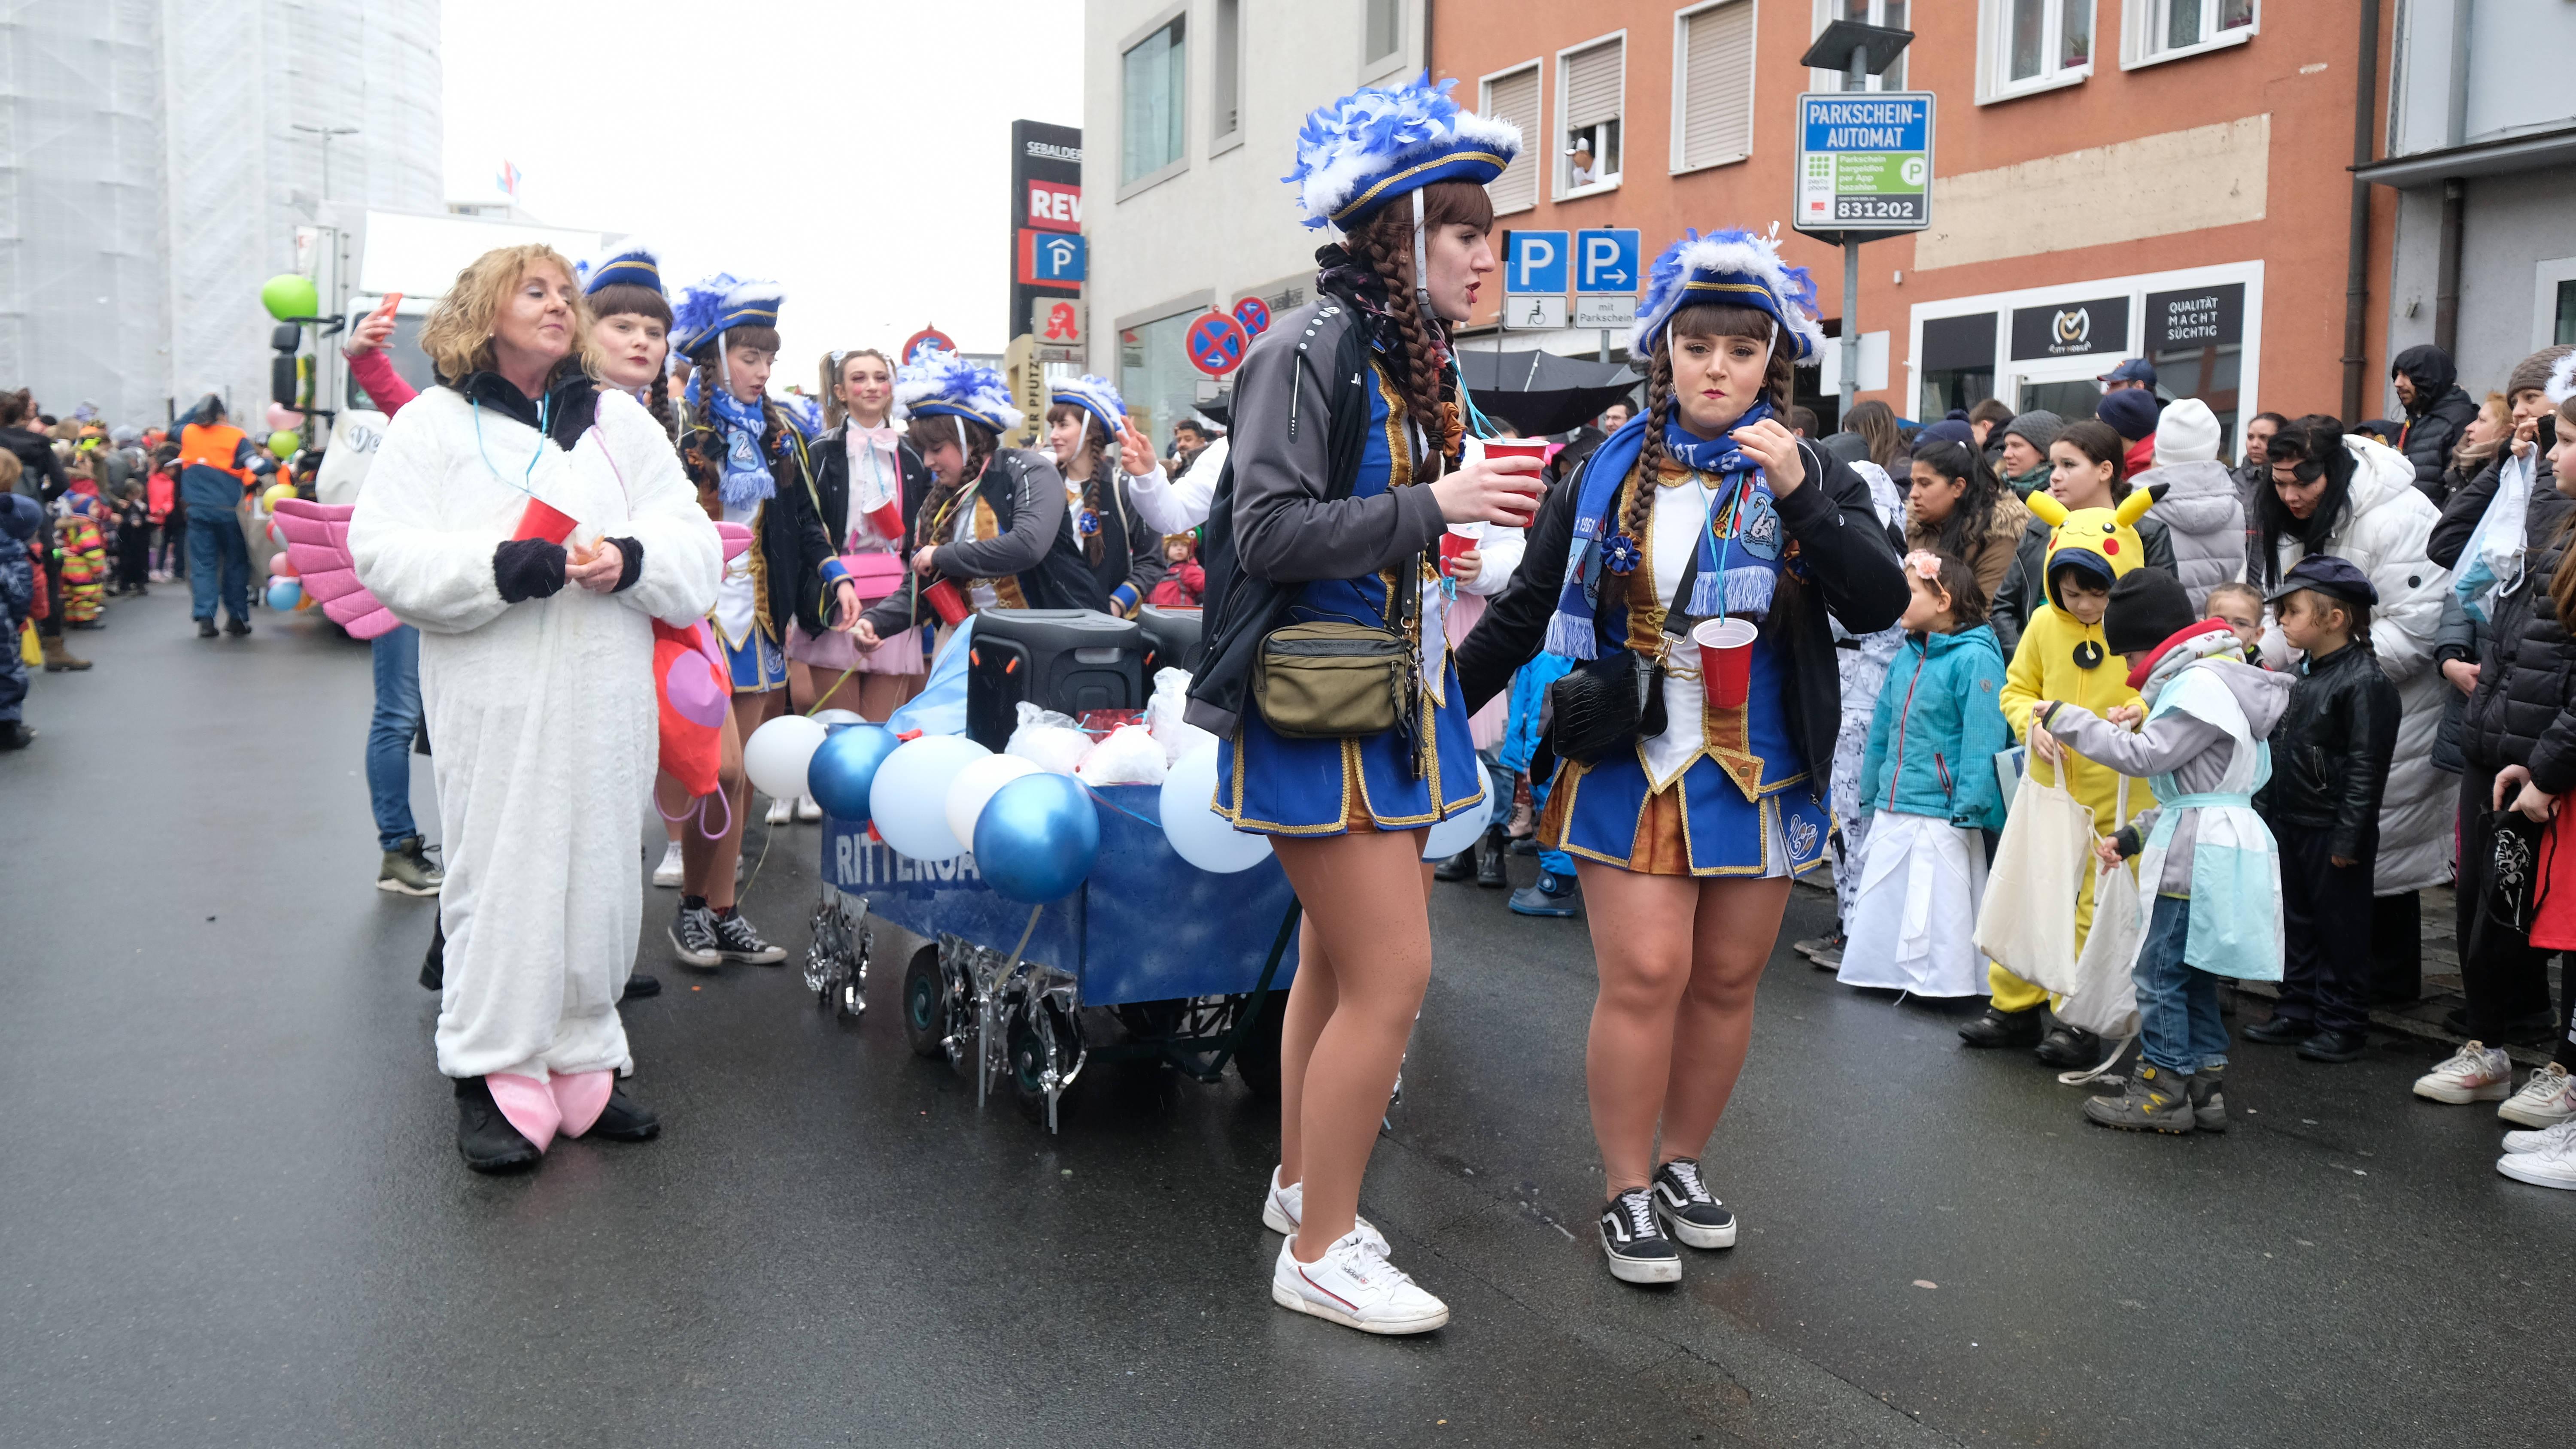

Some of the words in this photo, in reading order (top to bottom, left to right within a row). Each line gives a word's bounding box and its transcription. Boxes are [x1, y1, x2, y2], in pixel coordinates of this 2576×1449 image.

[1810, 104, 1922, 124] PARKSCHEIN-
[1827, 127, 1905, 148] AUTOMAT
[1839, 165, 1884, 173] bargeldlos
[1909, 163, 1922, 180] P
[1856, 174, 1874, 182] App
[1838, 202, 1914, 218] 831202
[1052, 248, 1072, 276] P
[1521, 239, 1555, 285] P
[1586, 237, 1621, 285] P
[2169, 296, 2219, 314] QUALITÄT
[1580, 313, 1633, 322] Parkschein
[2168, 311, 2218, 326] MACHT
[2168, 325, 2218, 340] SÜCHTIG
[1029, 413, 1039, 435] ER
[1579, 516, 1596, 533] 1961
